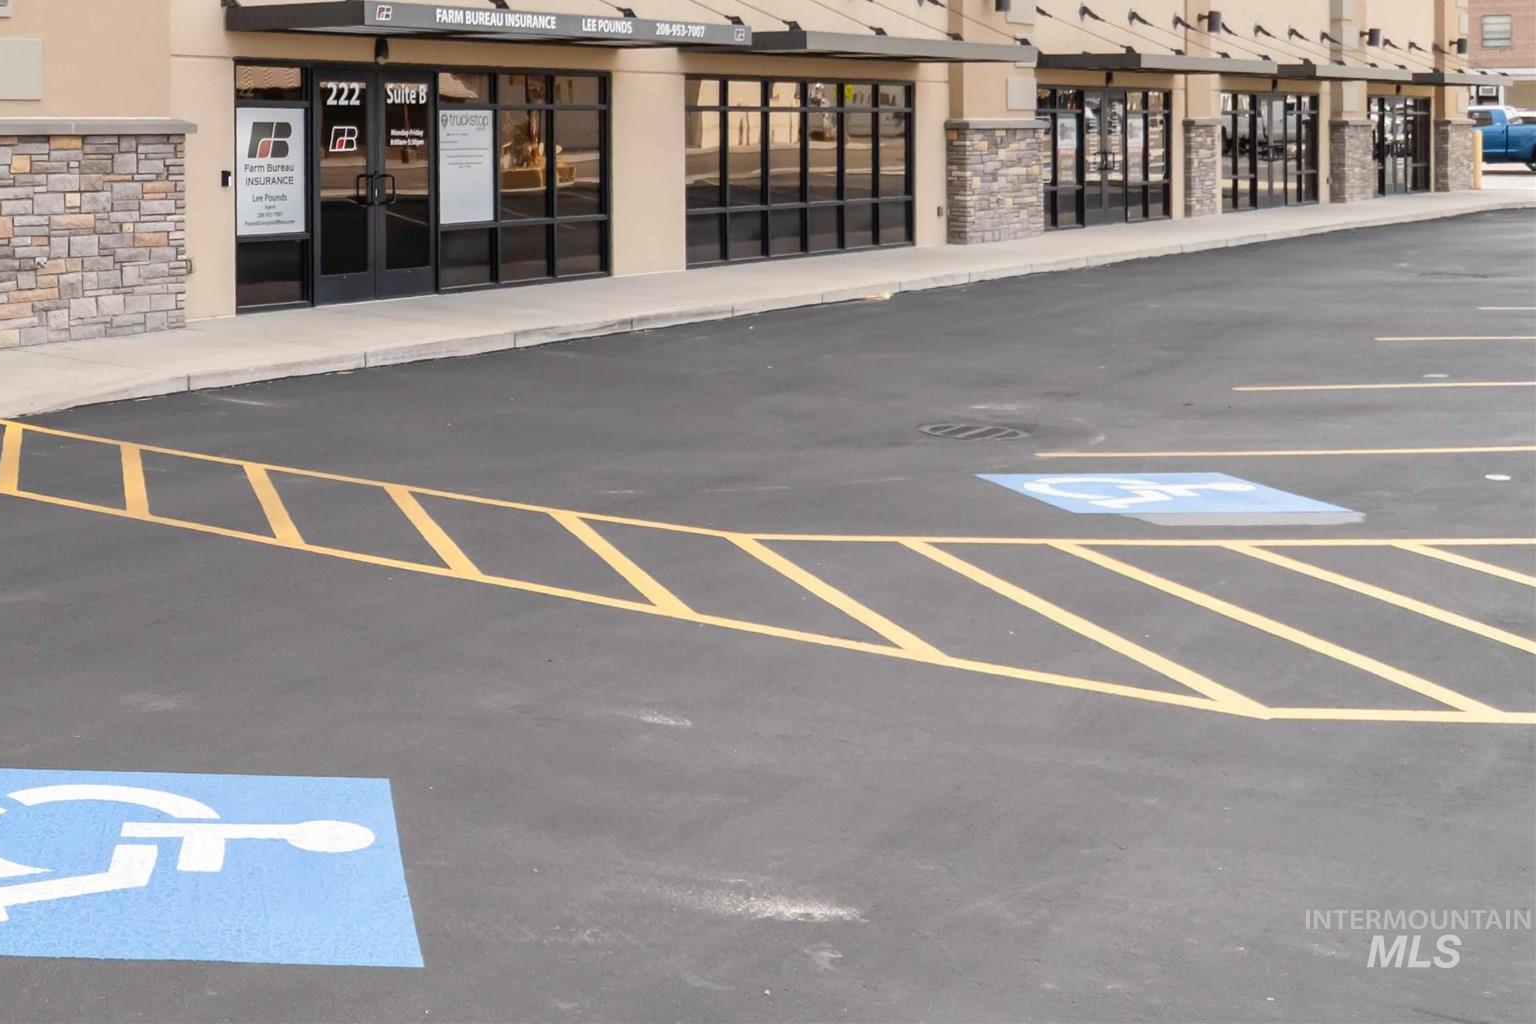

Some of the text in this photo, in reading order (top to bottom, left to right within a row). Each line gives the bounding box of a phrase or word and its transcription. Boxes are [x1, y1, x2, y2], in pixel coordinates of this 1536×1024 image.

[435, 8, 557, 30] FARM BUREAU INSURANCE
[582, 18, 633, 34] LEE POUNDS
[655, 22, 705, 38] 208-953-7007
[326, 82, 361, 106] 222
[386, 84, 428, 104] Suite B
[449, 113, 489, 127] truckstop
[244, 163, 294, 173] Farm Bureau
[245, 176, 294, 186] INSURANCE
[252, 193, 288, 203] Lee Pounds
